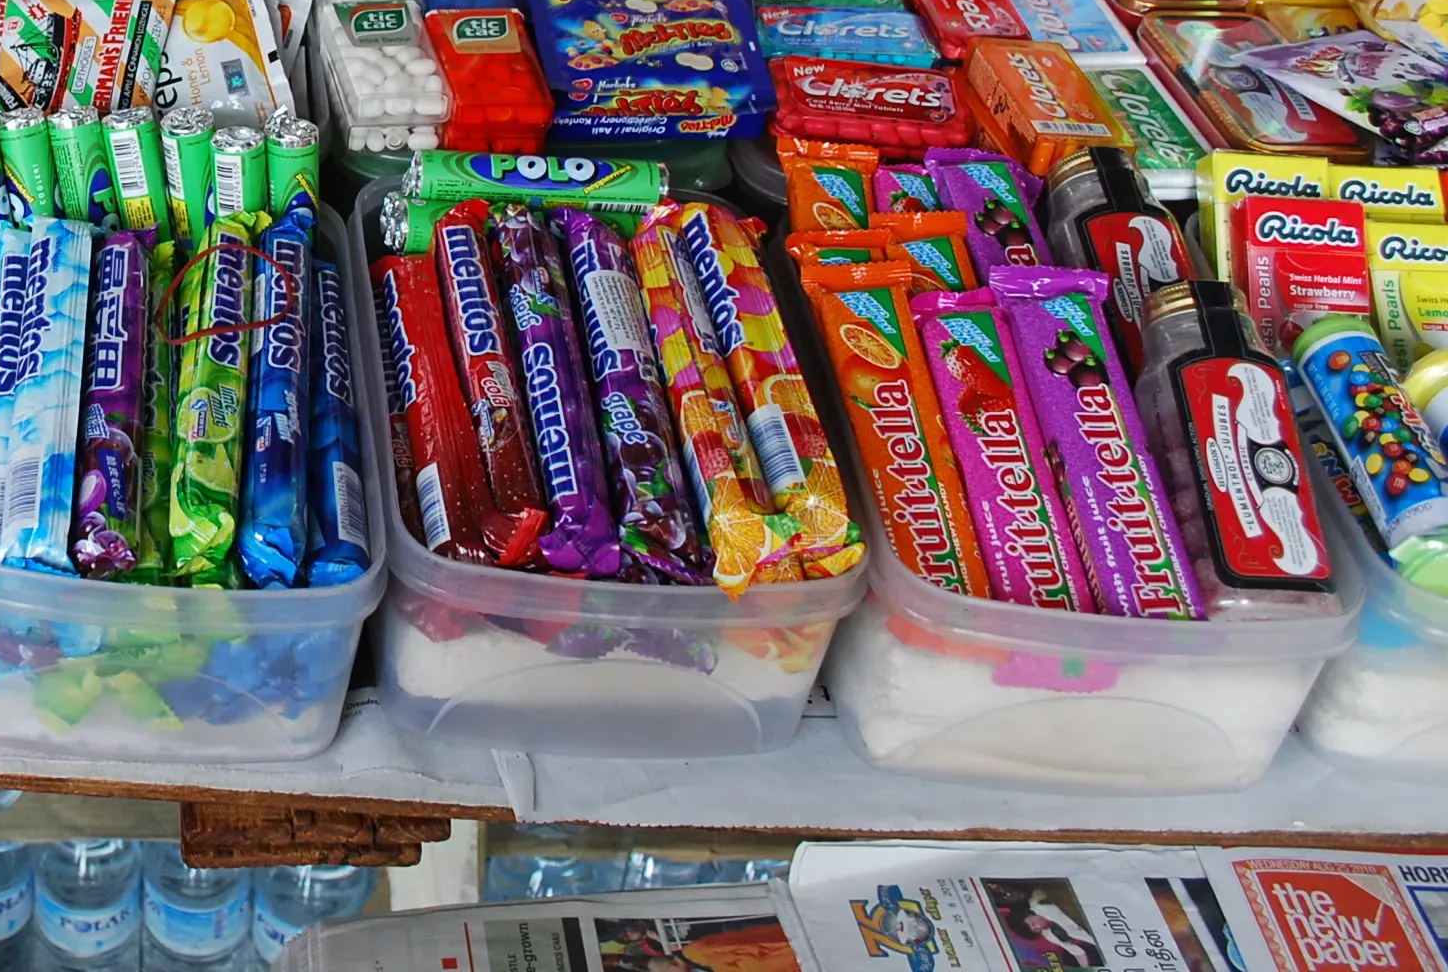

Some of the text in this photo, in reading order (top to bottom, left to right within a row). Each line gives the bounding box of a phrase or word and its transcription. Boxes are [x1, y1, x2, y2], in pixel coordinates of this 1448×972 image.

[137, 3, 150, 34] LOZENGES
[362, 21, 397, 29] tac
[369, 12, 396, 22] tic
[464, 28, 500, 36] tac
[471, 19, 499, 28] tic
[777, 17, 910, 39] Clorets
[73, 36, 95, 92] LOFTHOUSE'S
[92, 47, 120, 110] ERMAN'S
[194, 47, 211, 85] Lemon
[793, 62, 825, 78] New
[190, 71, 201, 105] Honey
[802, 76, 942, 107] Clorets
[490, 155, 598, 182] POLO
[1226, 169, 1321, 198] Ricola
[1258, 214, 1356, 244] Ricola
[443, 225, 501, 357] mentos
[684, 209, 746, 359] mentos
[1256, 256, 1271, 310] Pearls
[1289, 274, 1362, 285] Swiss Herbal Mint
[1290, 285, 1356, 300] Strawberry
[18, 237, 53, 382] mentos
[208, 232, 245, 368] mentos
[523, 341, 580, 500] mentos
[600, 391, 647, 444] grape
[1217, 403, 1232, 452] JUJUBES
[1136, 453, 1154, 491] CANDY
[1208, 440, 1226, 490] HUDSON'S
[1082, 476, 1103, 524] juice
[1152, 493, 1168, 530] CHEWY
[1097, 526, 1115, 568] fruit
[1247, 860, 1311, 870] WEDNESDAY
[1313, 862, 1333, 871] AUG
[1272, 882, 1336, 916] the
[1285, 913, 1364, 940] new
[1299, 937, 1397, 972] paper
